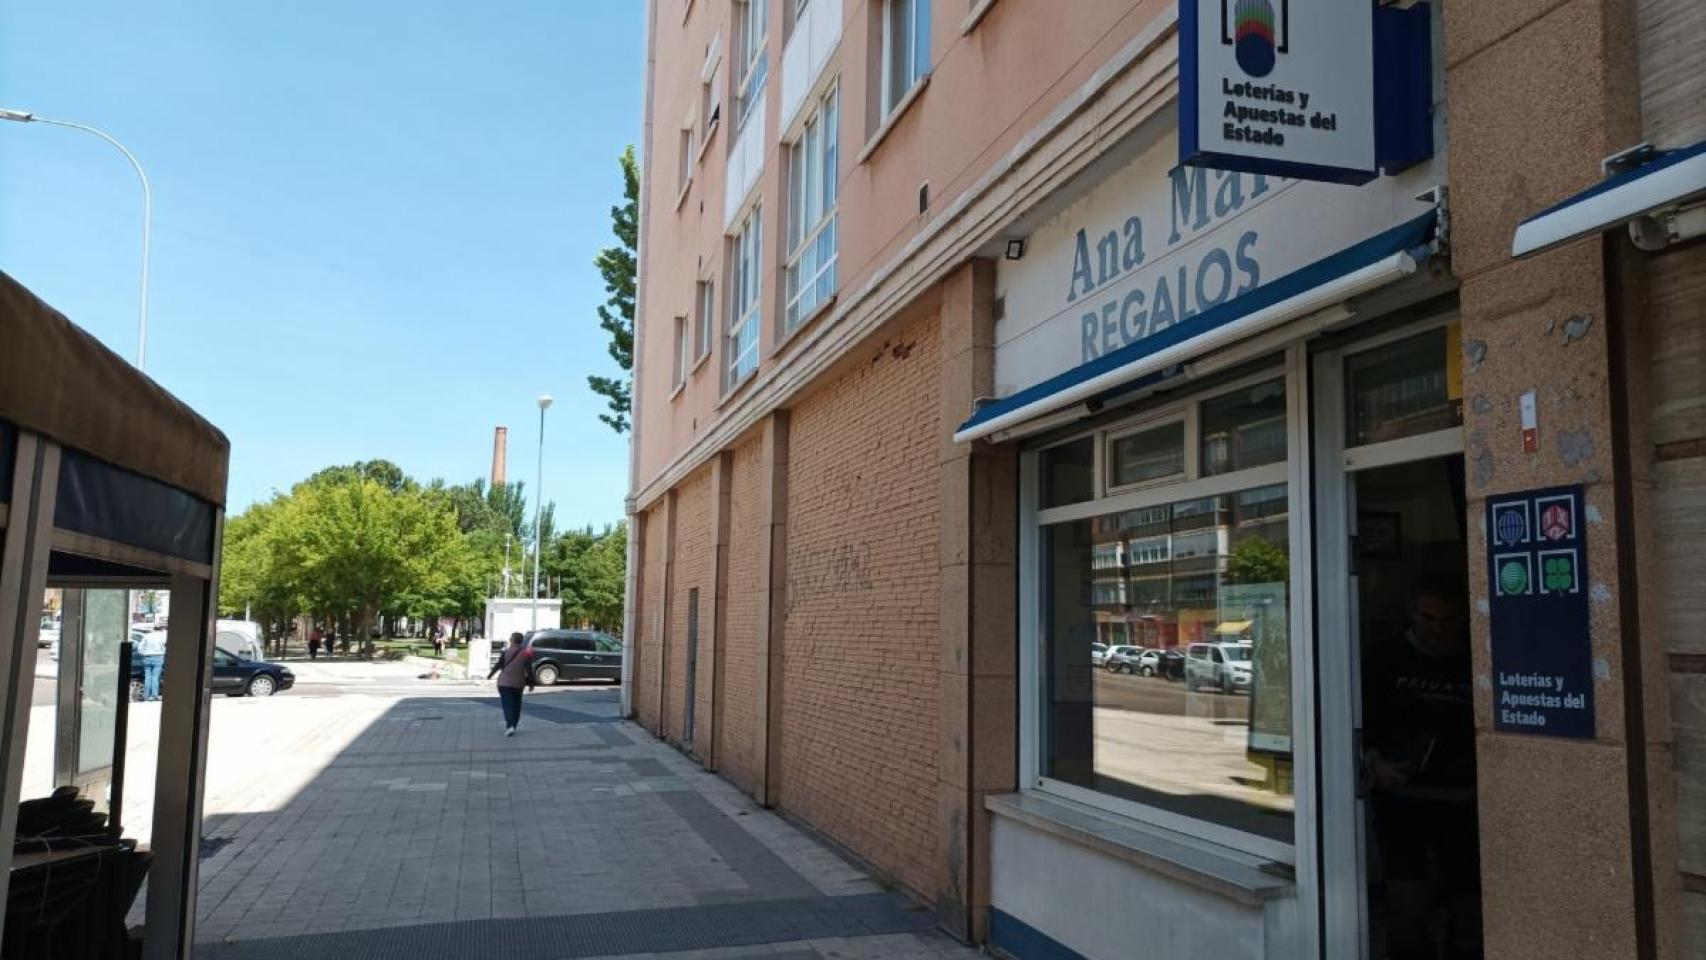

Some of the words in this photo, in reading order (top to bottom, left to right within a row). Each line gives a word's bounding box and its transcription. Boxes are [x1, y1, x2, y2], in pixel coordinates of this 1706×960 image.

[1223, 77, 1295, 104] Loterías
[1298, 92, 1310, 110] y
[1224, 101, 1306, 127] Apuestas
[1310, 111, 1336, 131] del
[1223, 122, 1284, 146] Estado
[1067, 215, 1146, 303] Ana
[1081, 230, 1261, 364] REGALOS
[1500, 672, 1552, 688] Loterías
[1555, 676, 1564, 692] y
[1501, 690, 1562, 708] Apuestas
[1563, 692, 1585, 709] del
[1502, 708, 1546, 726] Estado
